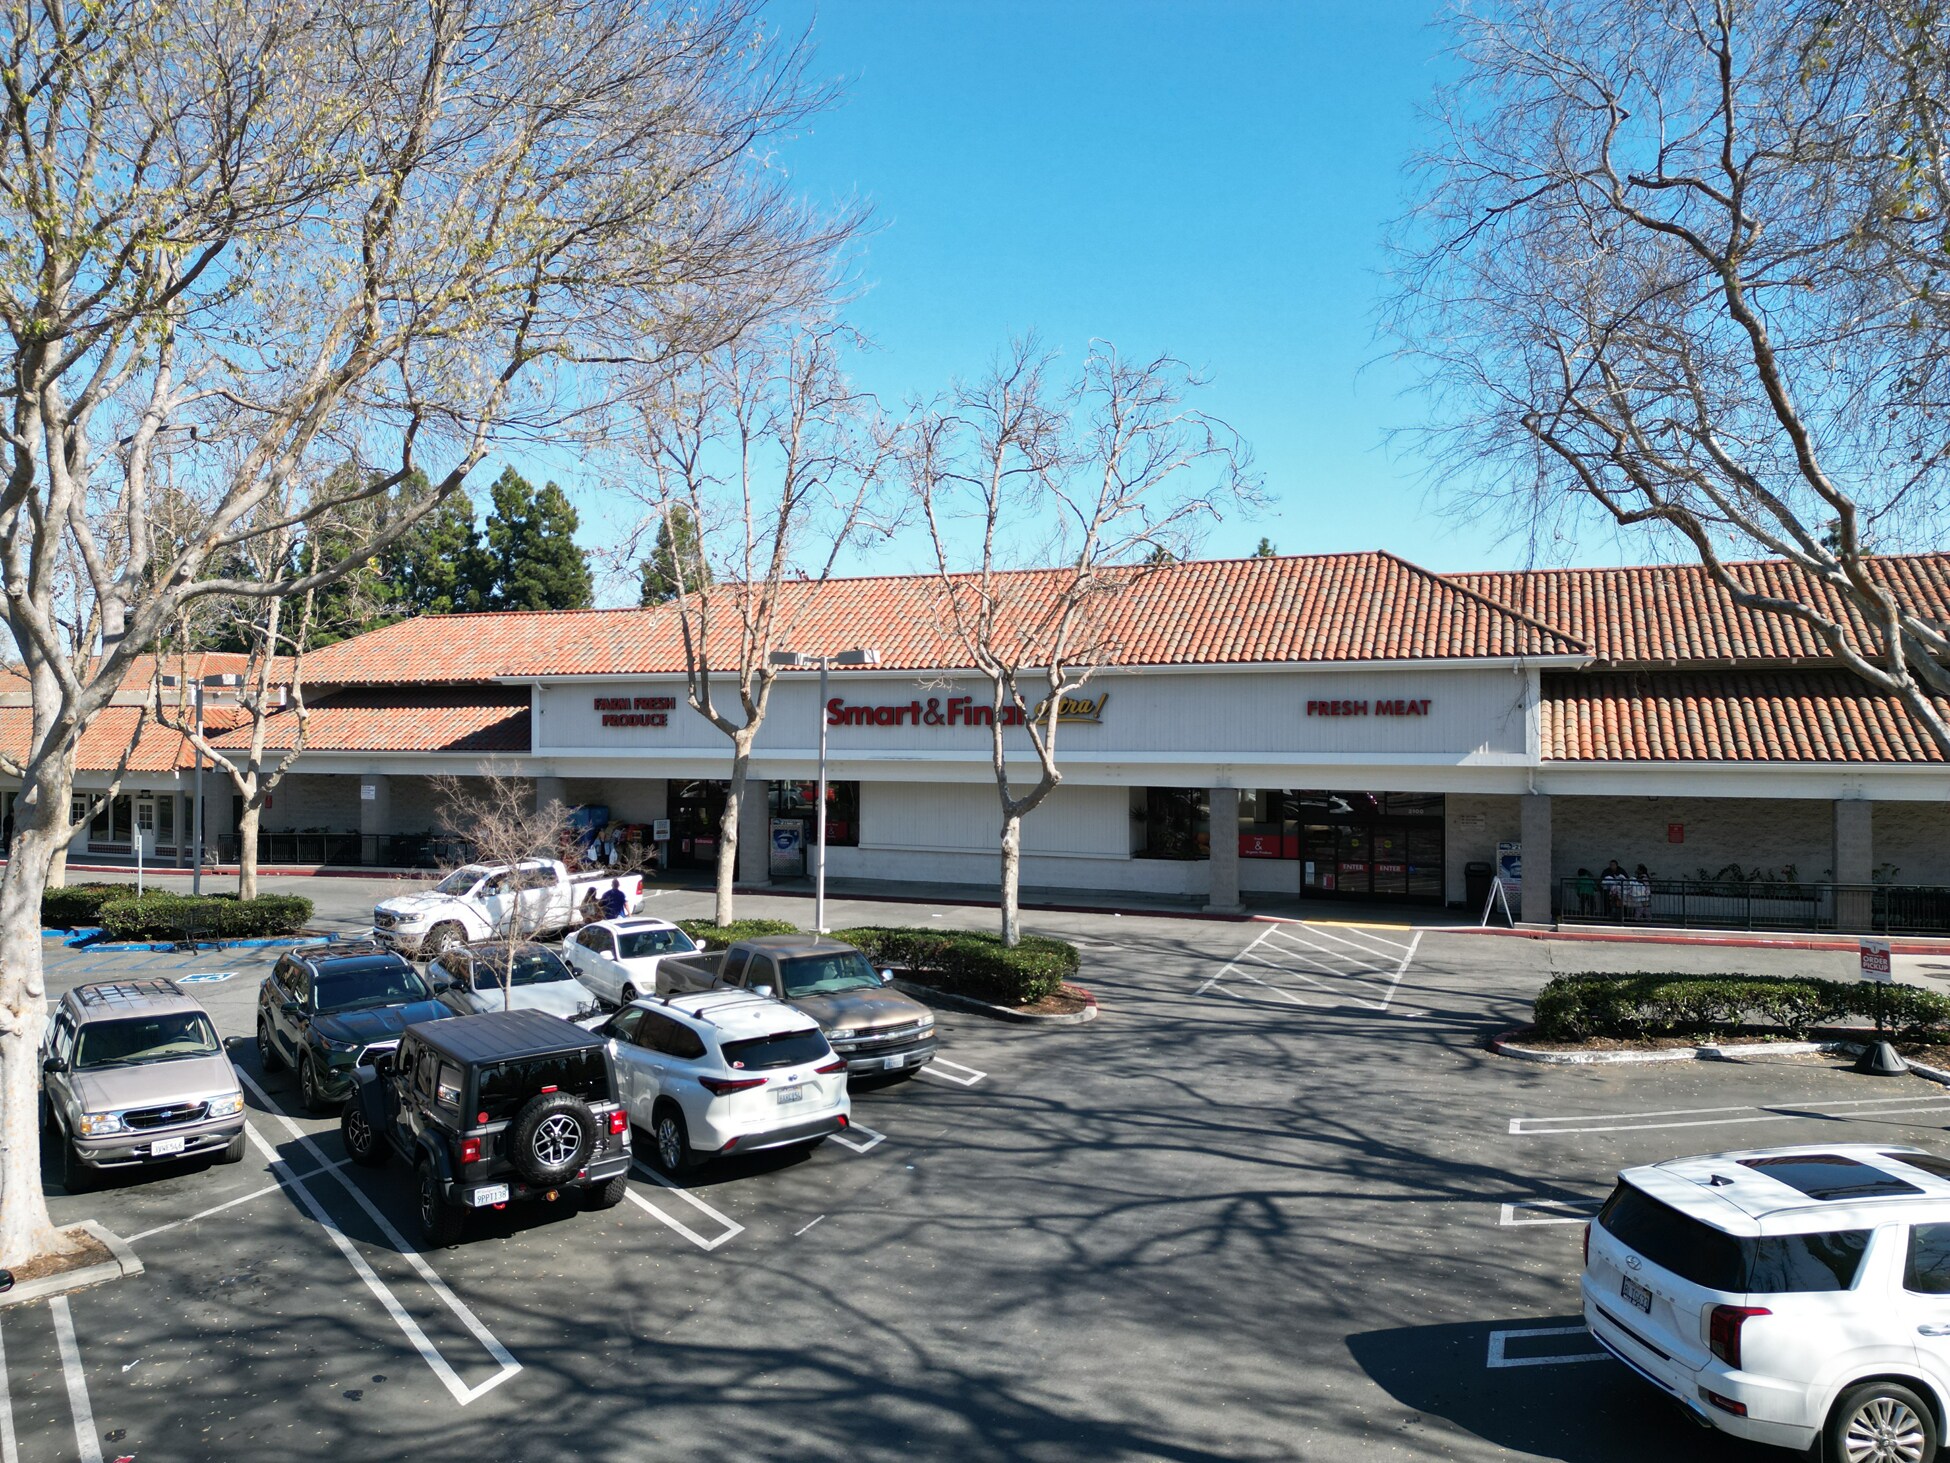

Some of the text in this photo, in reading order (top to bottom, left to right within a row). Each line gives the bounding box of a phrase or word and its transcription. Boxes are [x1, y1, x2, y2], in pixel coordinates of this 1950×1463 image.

[593, 696, 676, 710] FARM FRESH
[1307, 699, 1432, 716] FRESH MEAT
[602, 713, 668, 727] PRODUCE
[1343, 863, 1364, 871] ENTER
[1863, 955, 1888, 965] ORDER
[1863, 961, 1889, 971] PICKUP
